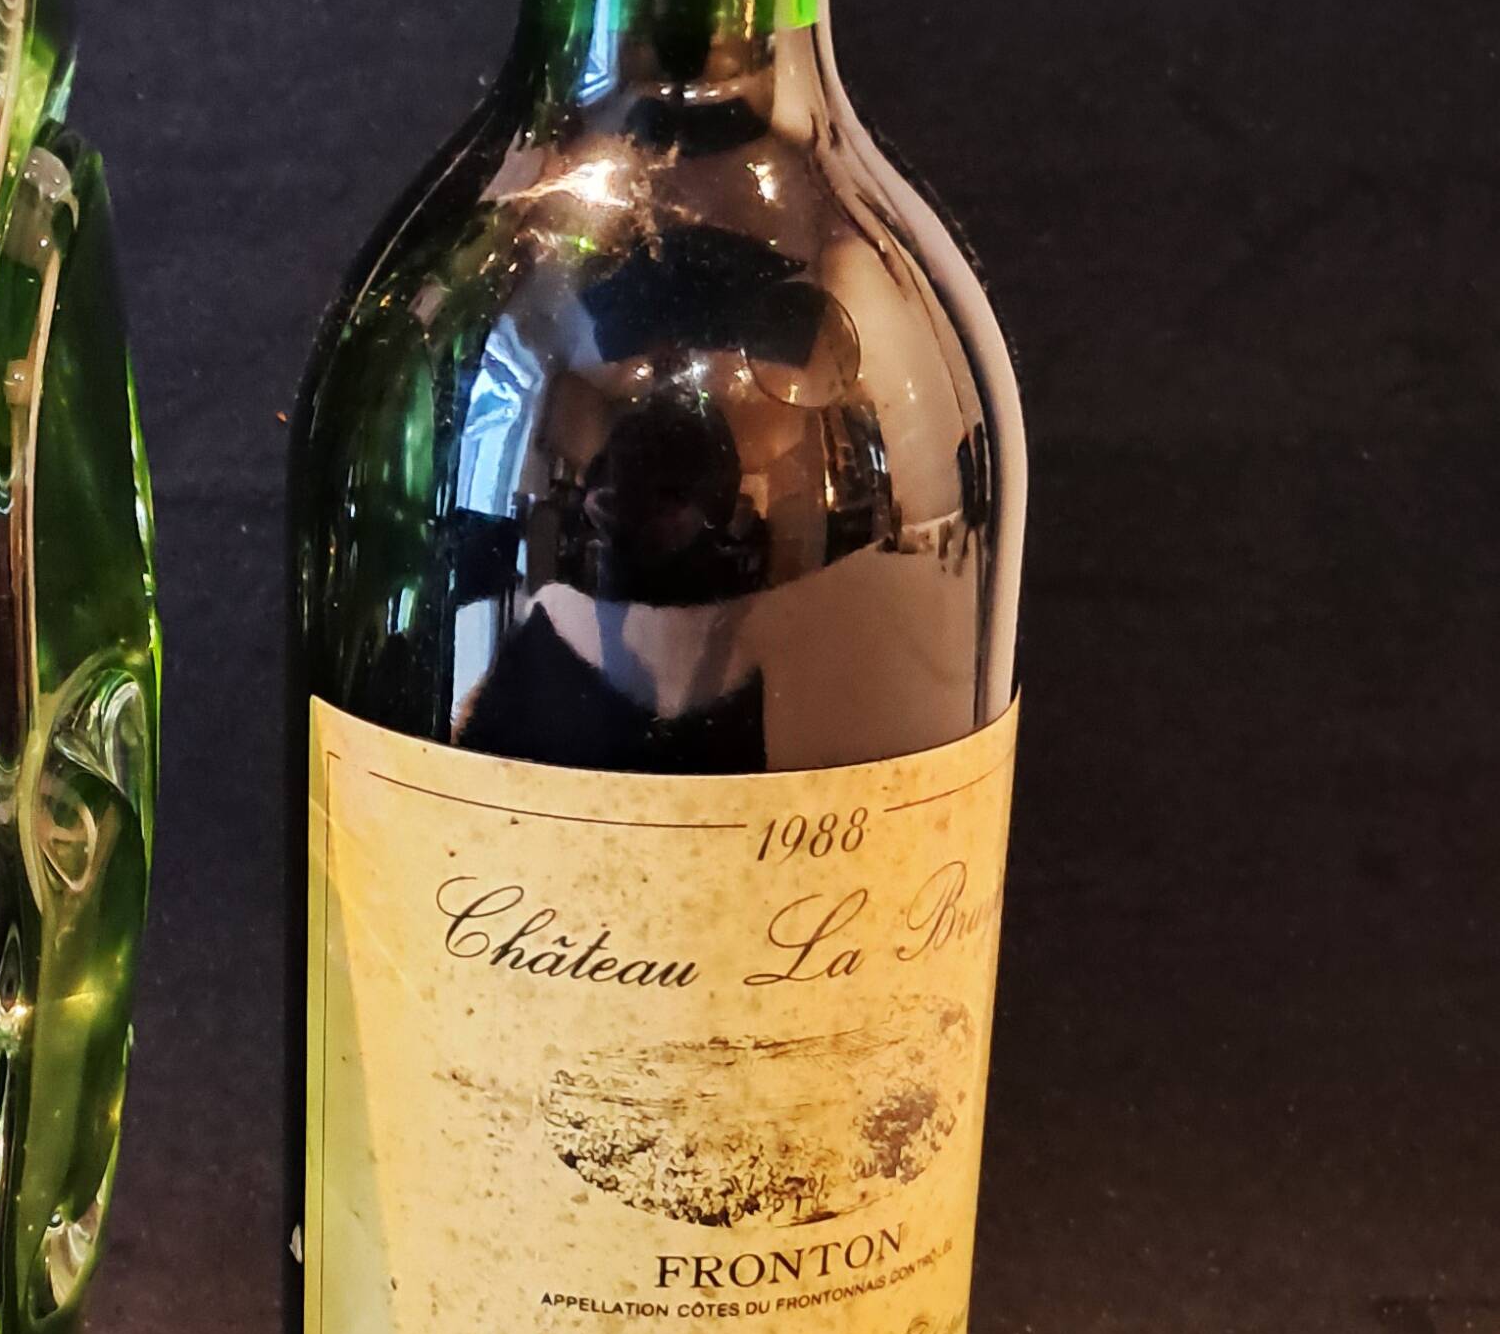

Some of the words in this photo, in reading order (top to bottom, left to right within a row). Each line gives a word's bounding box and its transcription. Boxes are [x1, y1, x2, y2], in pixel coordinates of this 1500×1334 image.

[757, 806, 868, 865] 1988
[436, 875, 700, 988] Château
[743, 888, 868, 986] La
[655, 1221, 904, 1289] FRONTON
[541, 1291, 669, 1318] APPELLATION
[677, 1301, 740, 1318] CÔTES
[745, 1300, 770, 1317] DU
[776, 1275, 886, 1312] FRONTONNAIS
